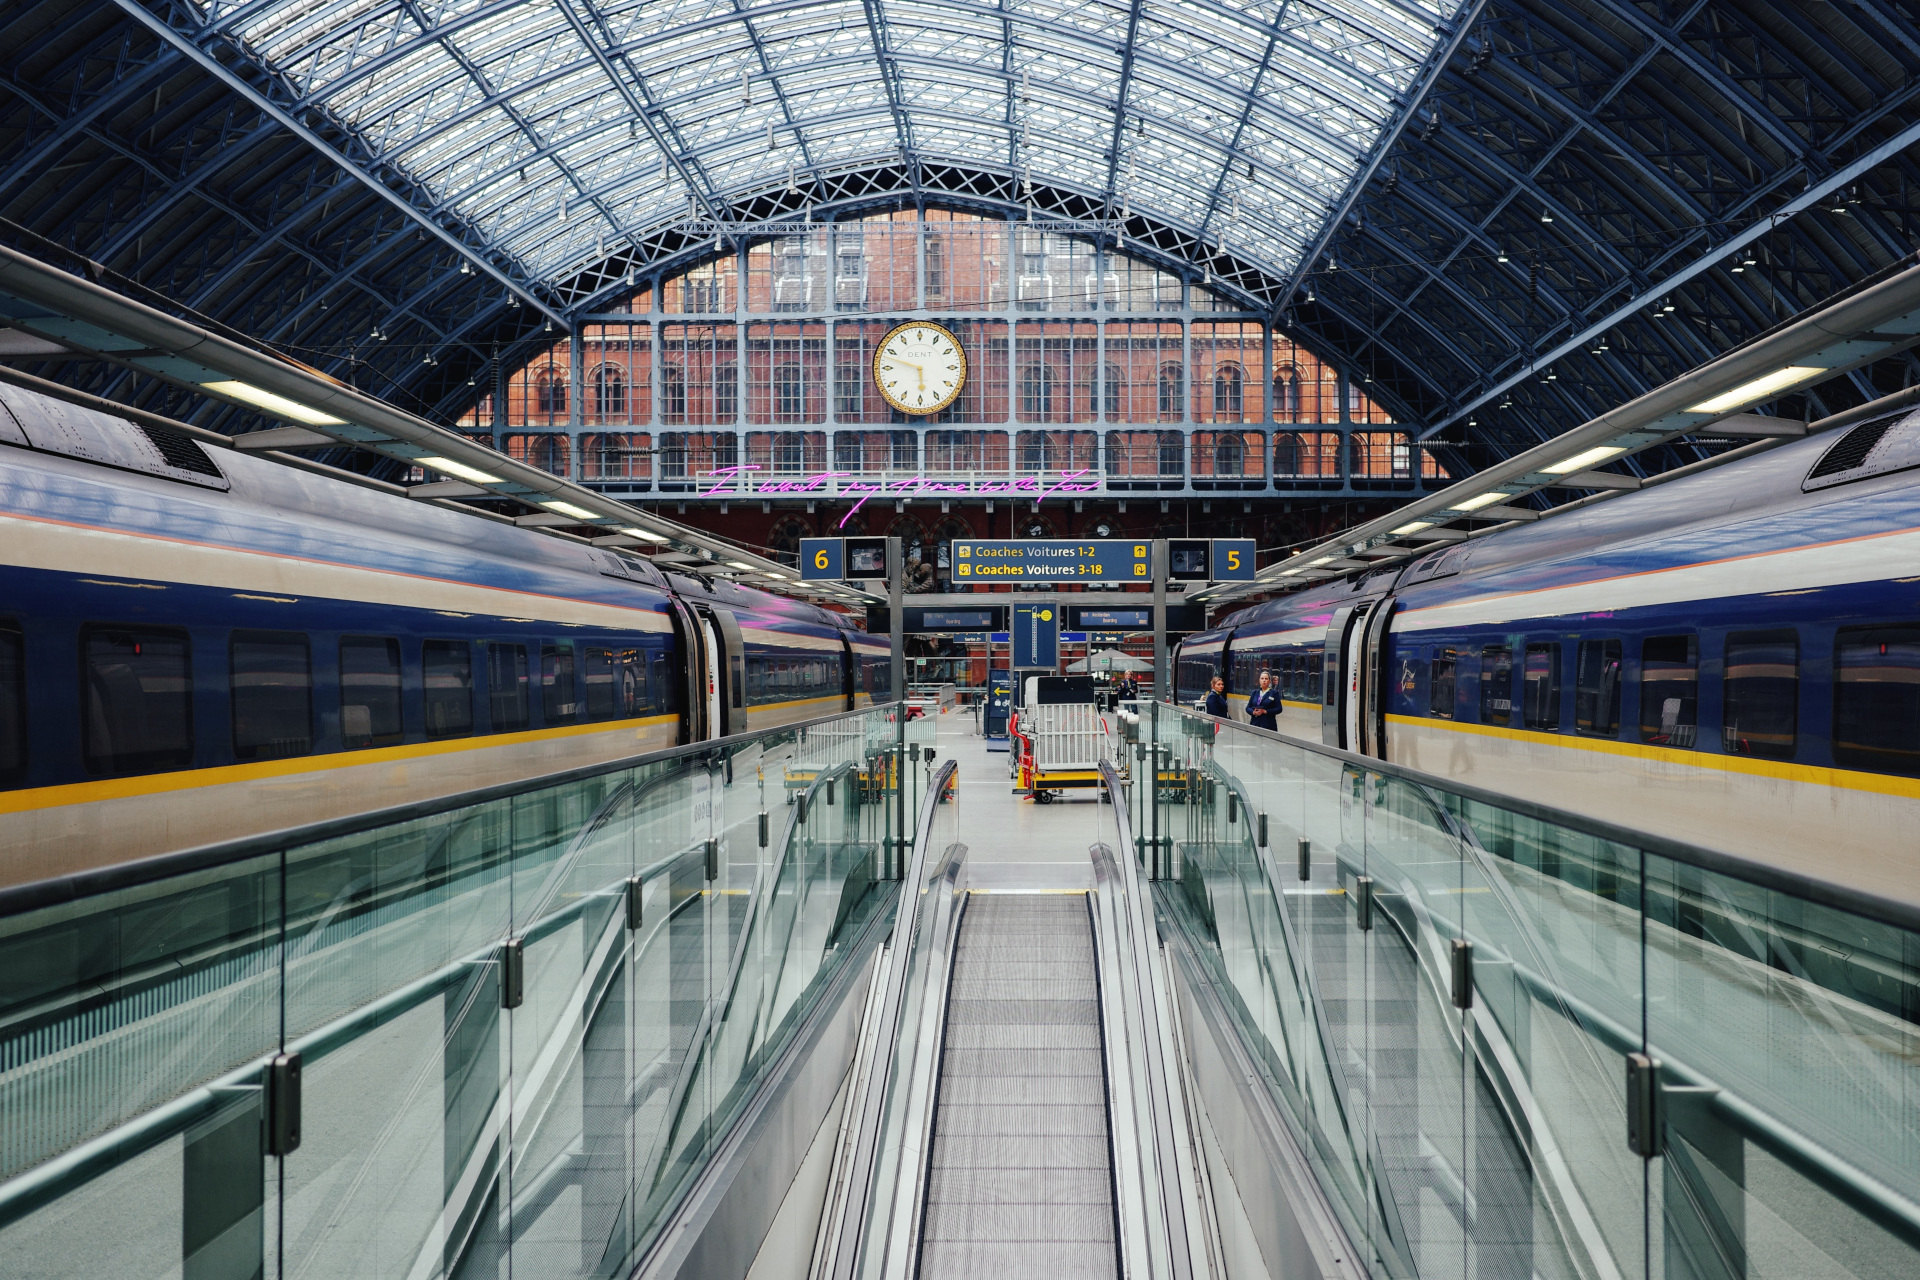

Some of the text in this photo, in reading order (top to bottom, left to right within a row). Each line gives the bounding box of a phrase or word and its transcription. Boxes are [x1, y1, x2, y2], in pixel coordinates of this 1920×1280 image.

[699, 465, 761, 498] I
[814, 549, 829, 570] 6
[975, 545, 1096, 557] Coaches Voitures 1-2
[1227, 550, 1241, 571] 5
[975, 564, 1103, 575] Coaches Voitures 3-18
